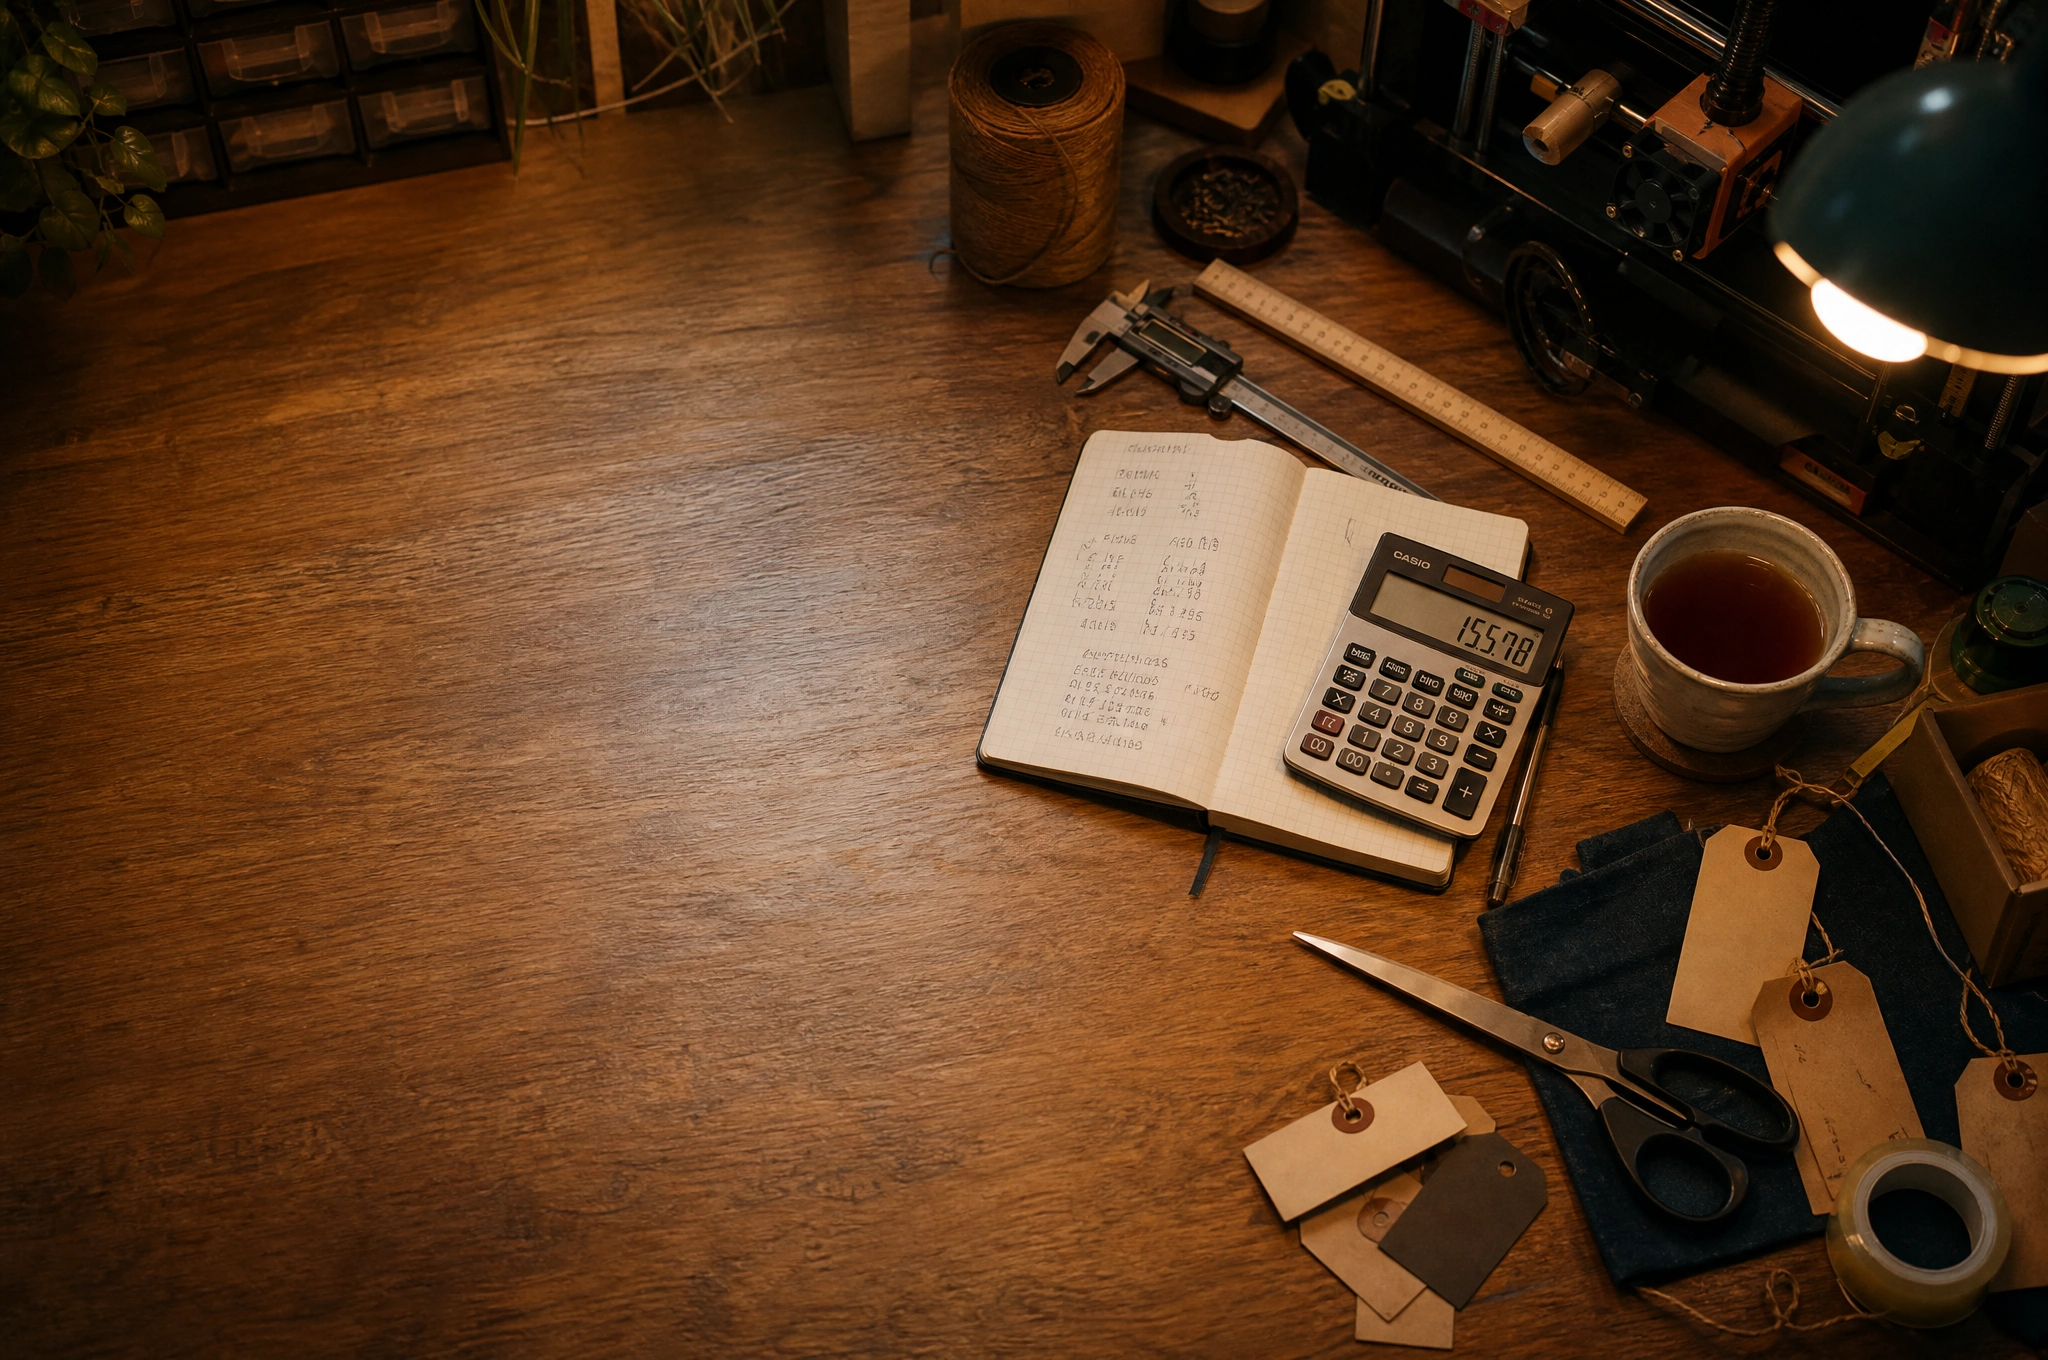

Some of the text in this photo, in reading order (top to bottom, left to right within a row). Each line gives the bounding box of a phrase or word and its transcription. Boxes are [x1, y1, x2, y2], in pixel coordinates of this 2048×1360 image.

[1393, 550, 1431, 570] CASIO
[1381, 685, 1392, 696] 7
[1413, 698, 1424, 711] 8
[1369, 708, 1381, 720] 4
[1447, 711, 1458, 724] 8
[1362, 731, 1369, 743] 1
[1393, 744, 1404, 758] 2
[1345, 752, 1364, 768] 00
[1427, 758, 1438, 771] 3
